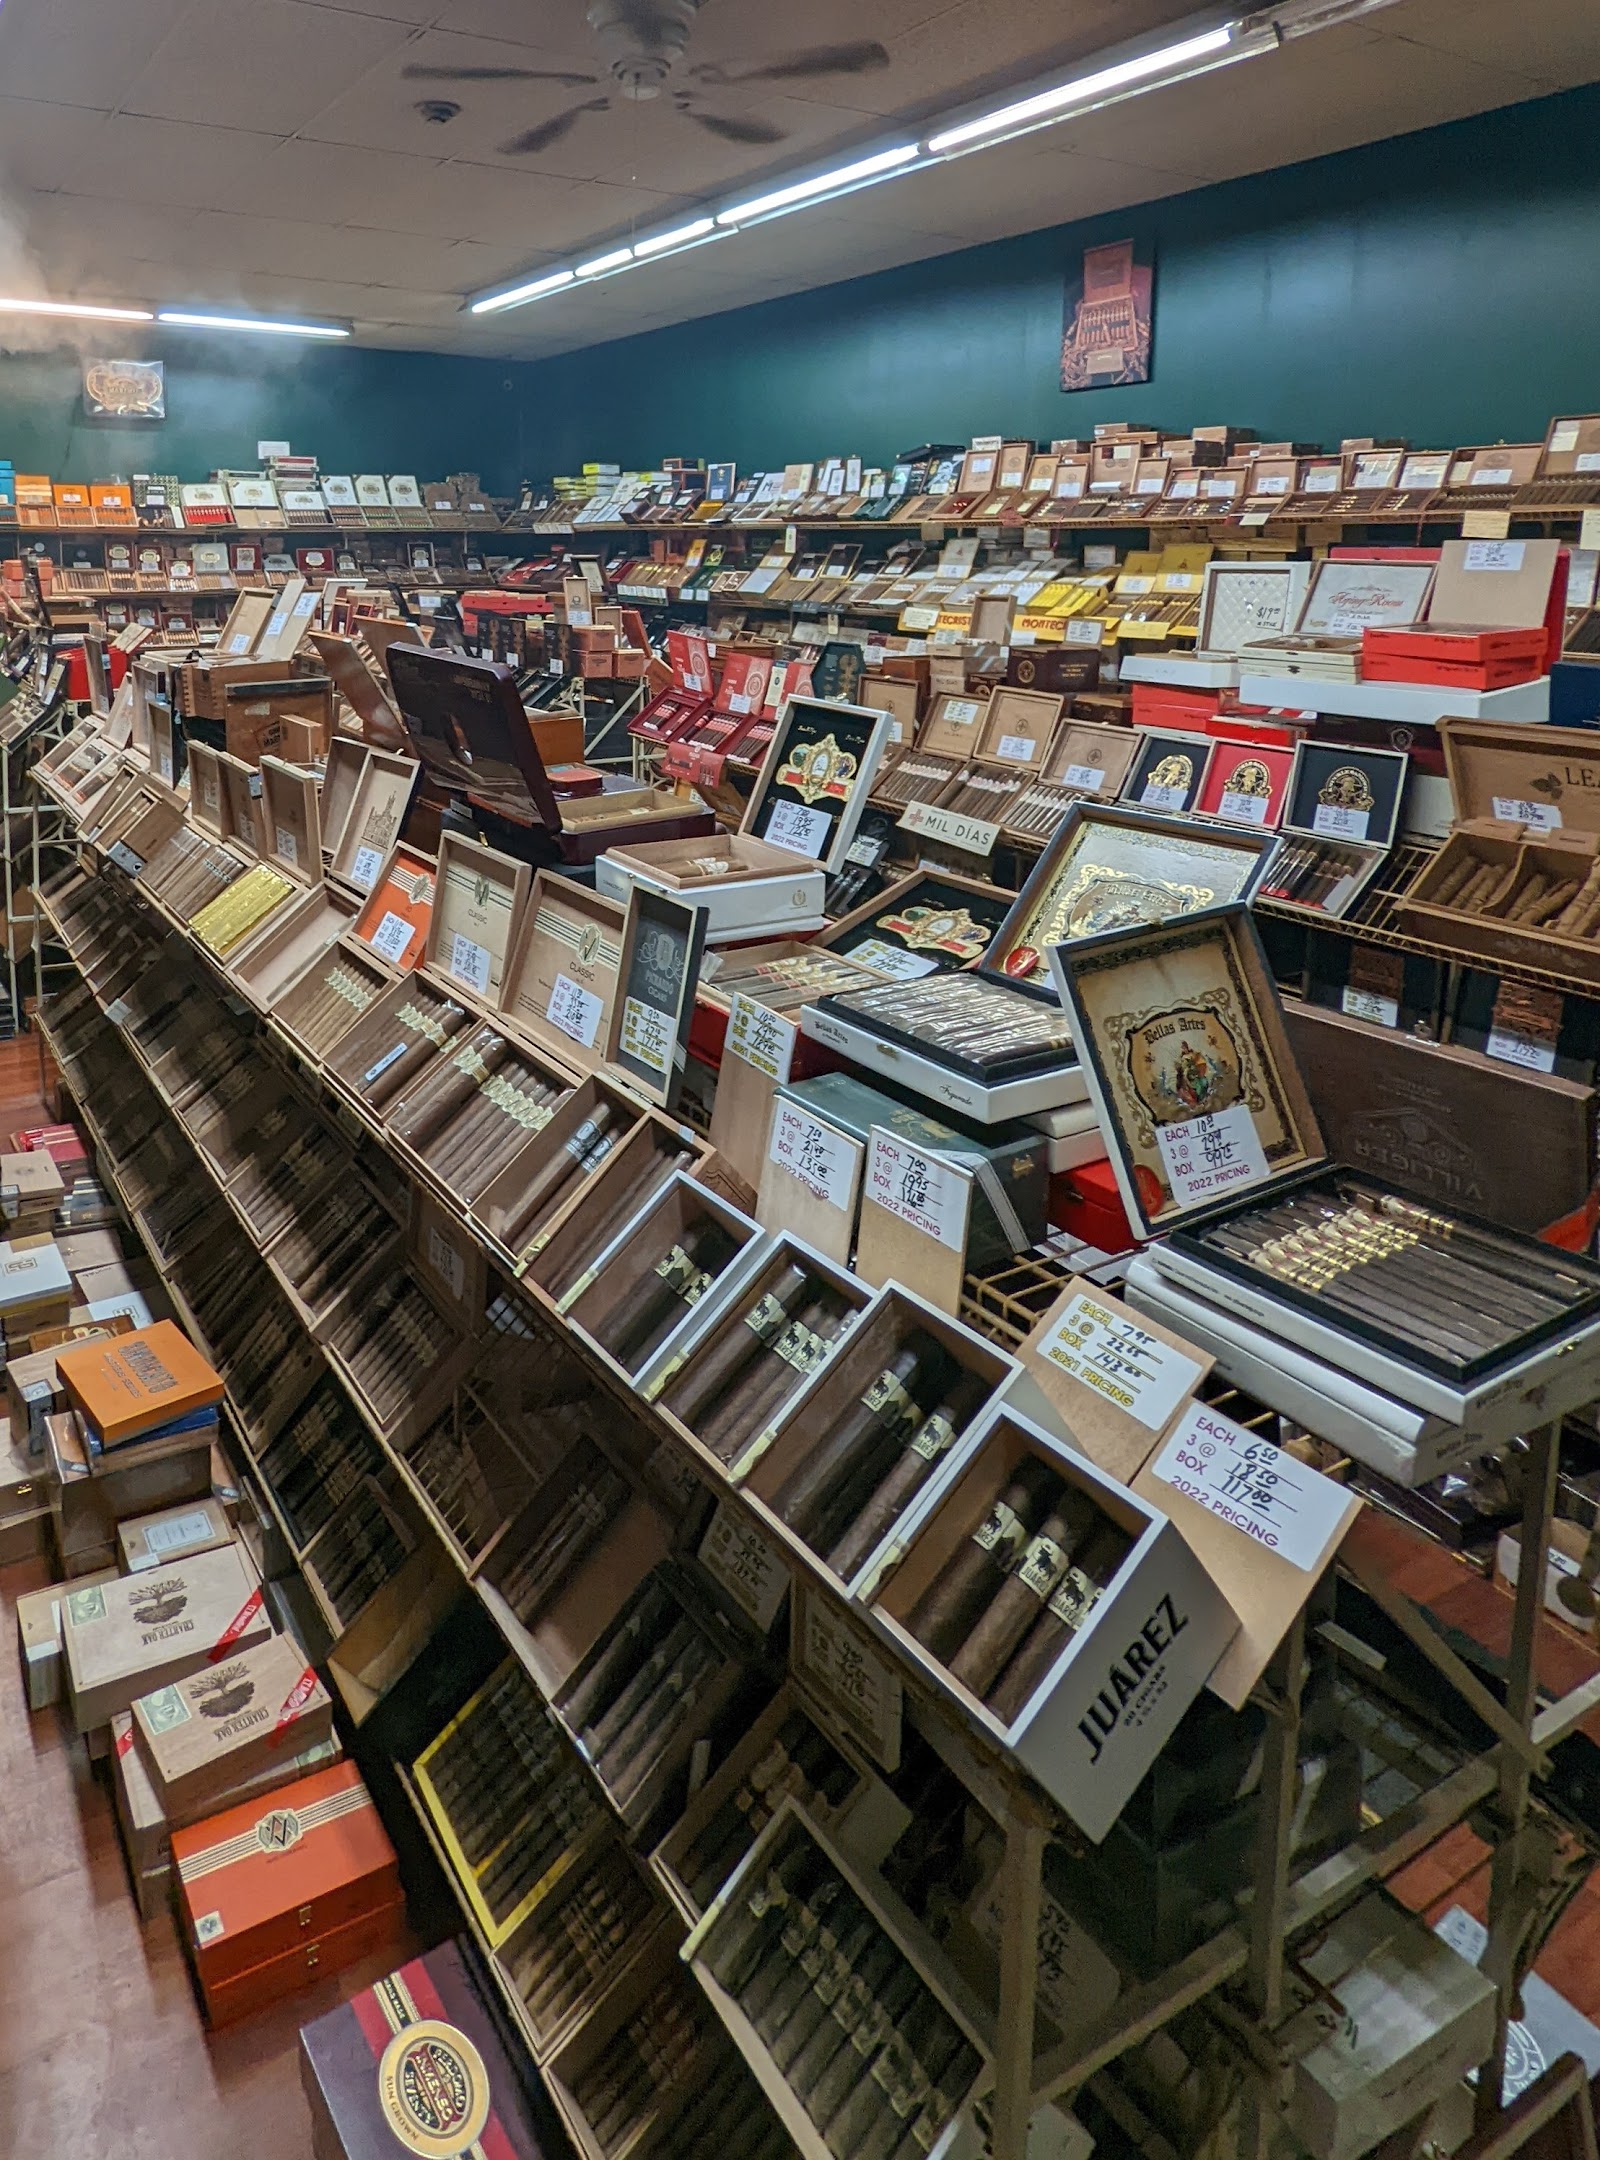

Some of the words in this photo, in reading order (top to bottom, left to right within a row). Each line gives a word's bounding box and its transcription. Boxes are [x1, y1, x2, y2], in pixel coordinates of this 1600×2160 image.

[1565, 767, 1600, 788] LE
[925, 816, 948, 832] MIL
[955, 824, 991, 845] DÍAS
[569, 961, 596, 982] CLASSIC
[1142, 1023, 1176, 1045] Bellas
[1179, 1017, 1206, 1032] Artes
[782, 1111, 802, 1131] EACH
[780, 1126, 786, 1136] 3
[787, 1130, 795, 1143] @
[1165, 1126, 1190, 1142] EACH
[777, 1140, 793, 1158] BOX
[877, 1141, 900, 1161] EACH
[1170, 1149, 1177, 1160] 3
[1179, 1145, 1189, 1159] @
[875, 1156, 881, 1168] 3
[883, 1161, 893, 1175] @
[1175, 1161, 1195, 1177] BOX
[797, 1172, 830, 1201] PRICING
[873, 1172, 891, 1190] BOX
[1187, 1176, 1214, 1193] 2022
[1214, 1165, 1251, 1184] PRICING
[877, 1192, 899, 1212] 2022
[902, 1207, 941, 1236] PRICING
[1068, 1314, 1080, 1326] 3
[1078, 1321, 1095, 1336] @
[1078, 1300, 1115, 1328] EACH
[1057, 1327, 1087, 1351] BOX
[1048, 1346, 1082, 1372] 2021
[1080, 1366, 1135, 1407] PRICING
[1195, 1416, 1237, 1446] EACH
[1186, 1433, 1197, 1446] 3
[1200, 1442, 1217, 1458] @
[1175, 1450, 1208, 1476] BOX
[1170, 1475, 1210, 1506] 2022
[1211, 1499, 1279, 1547] PRICING
[140, 1629, 160, 1647] OAK
[157, 1618, 195, 1641] CHARTER
[1075, 1592, 1190, 1766] JUÁREZ
[229, 1705, 271, 1733] CHARTER
[211, 1724, 233, 1743] OAK
[385, 2074, 398, 2102] SUN
[431, 2047, 467, 2110] PERDOMO
[388, 2100, 420, 2142] GROWN
